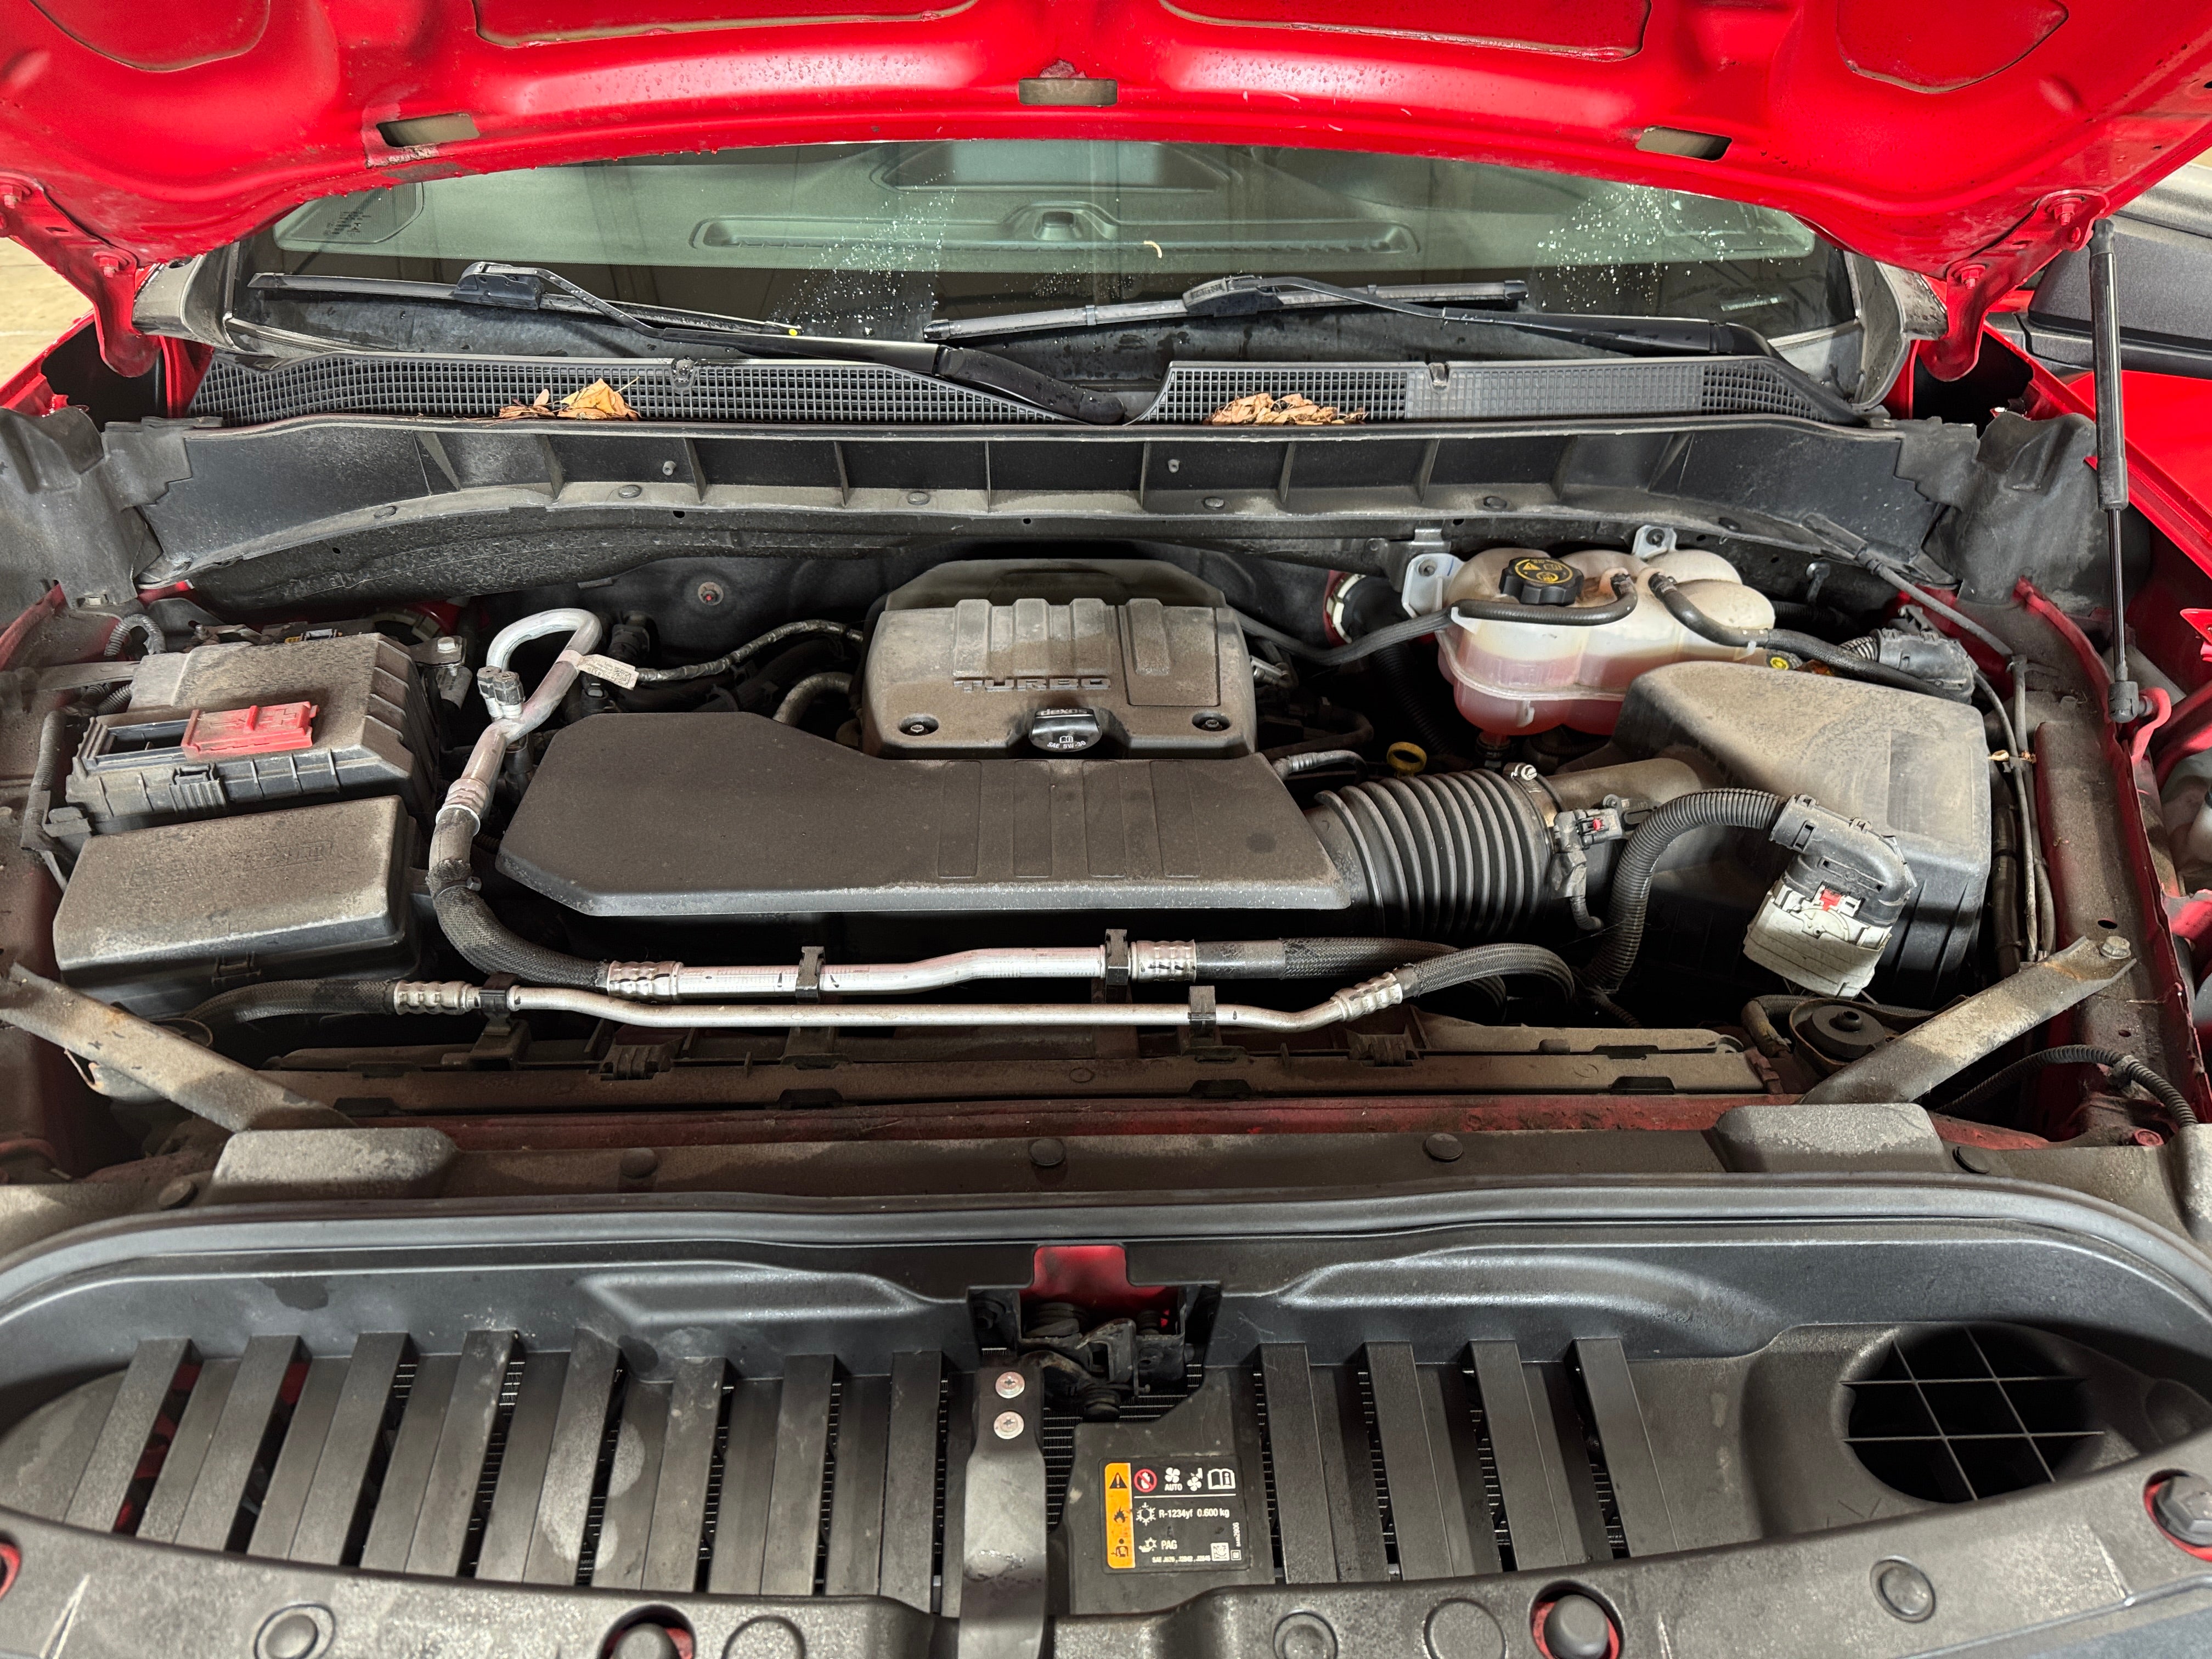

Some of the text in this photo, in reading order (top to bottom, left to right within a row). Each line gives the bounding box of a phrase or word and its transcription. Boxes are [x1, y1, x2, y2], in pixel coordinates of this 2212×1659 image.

[953, 678, 1111, 692] TURBO
[1164, 1483, 1183, 1491] AUTO
[1158, 1508, 1230, 1519] R-1234yf 0.600 kg
[1161, 1539, 1178, 1550] PAG
